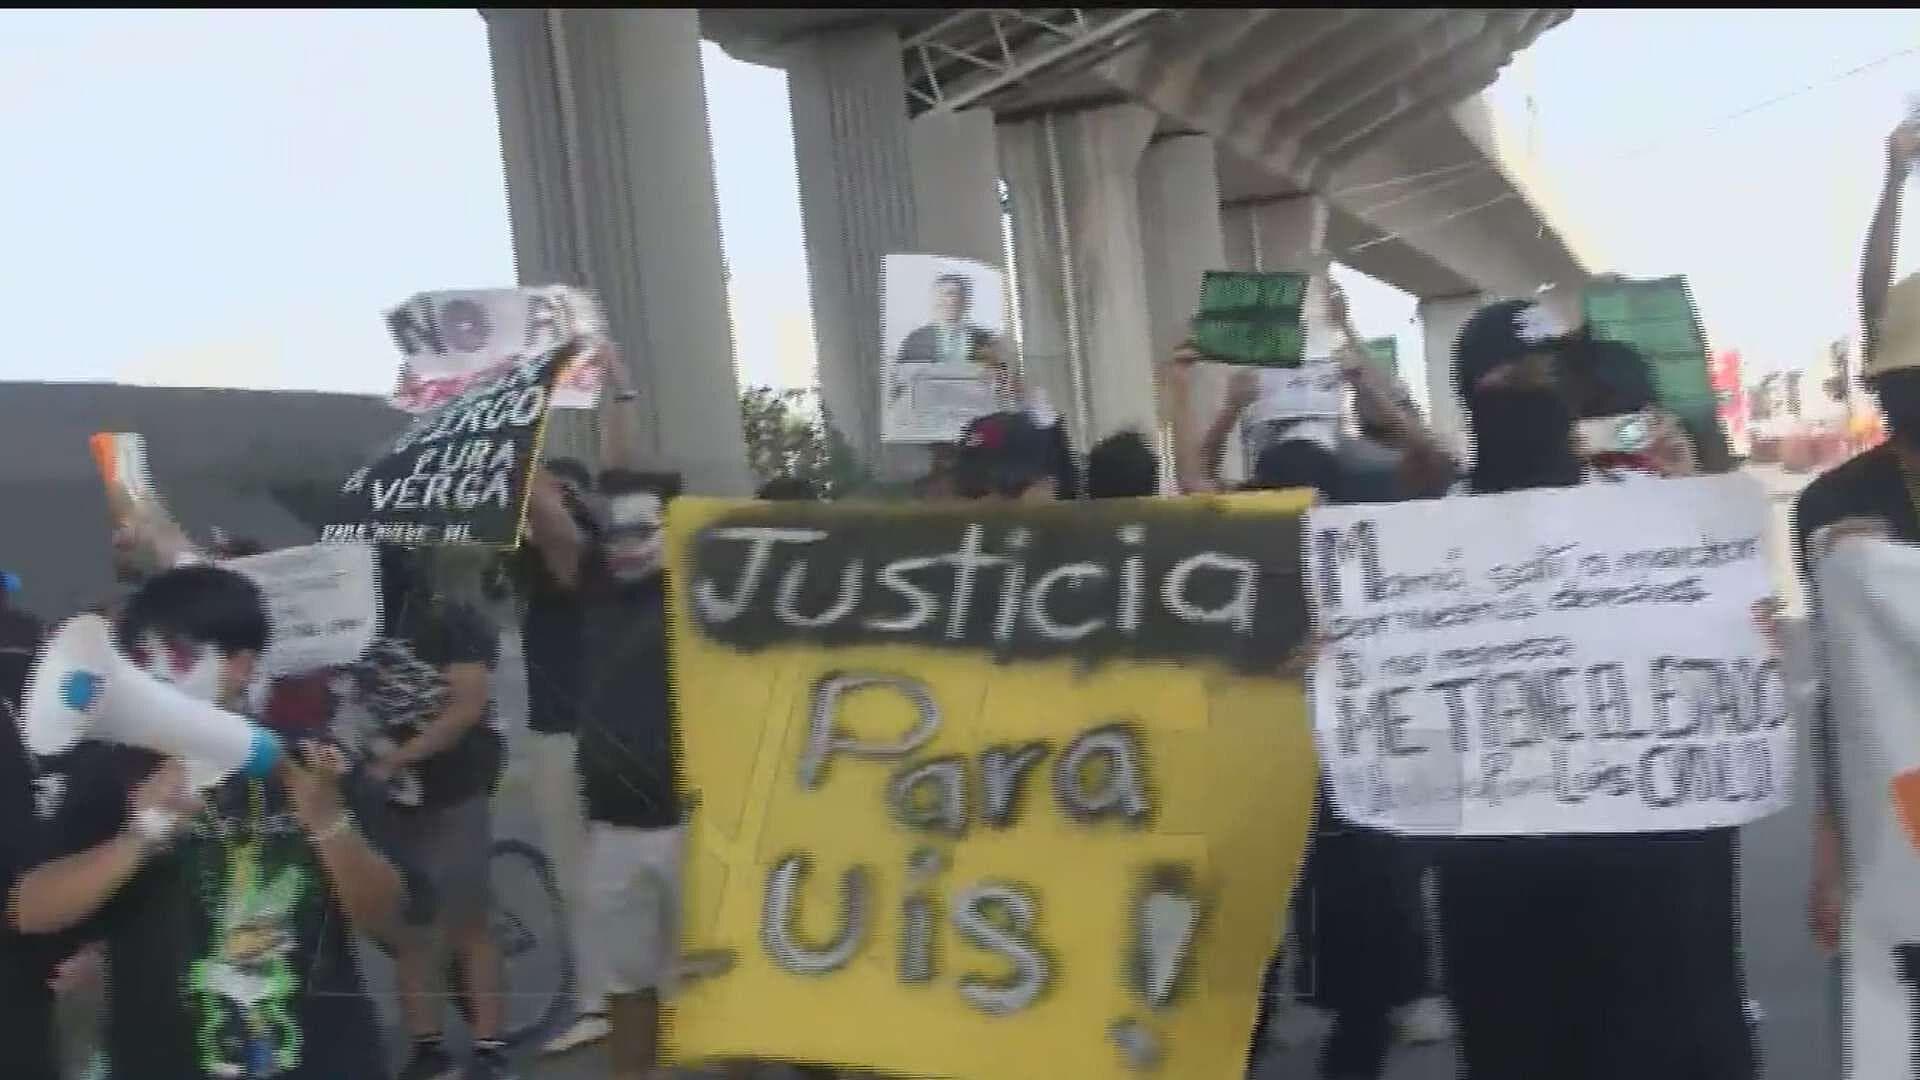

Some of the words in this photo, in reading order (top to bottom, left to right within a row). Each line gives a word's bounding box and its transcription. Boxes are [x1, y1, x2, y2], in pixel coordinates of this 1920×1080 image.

[370, 469, 512, 511] VERGA
[697, 523, 1261, 642] Justicia
[797, 668, 1160, 838] Para
[1336, 684, 1430, 757] ME
